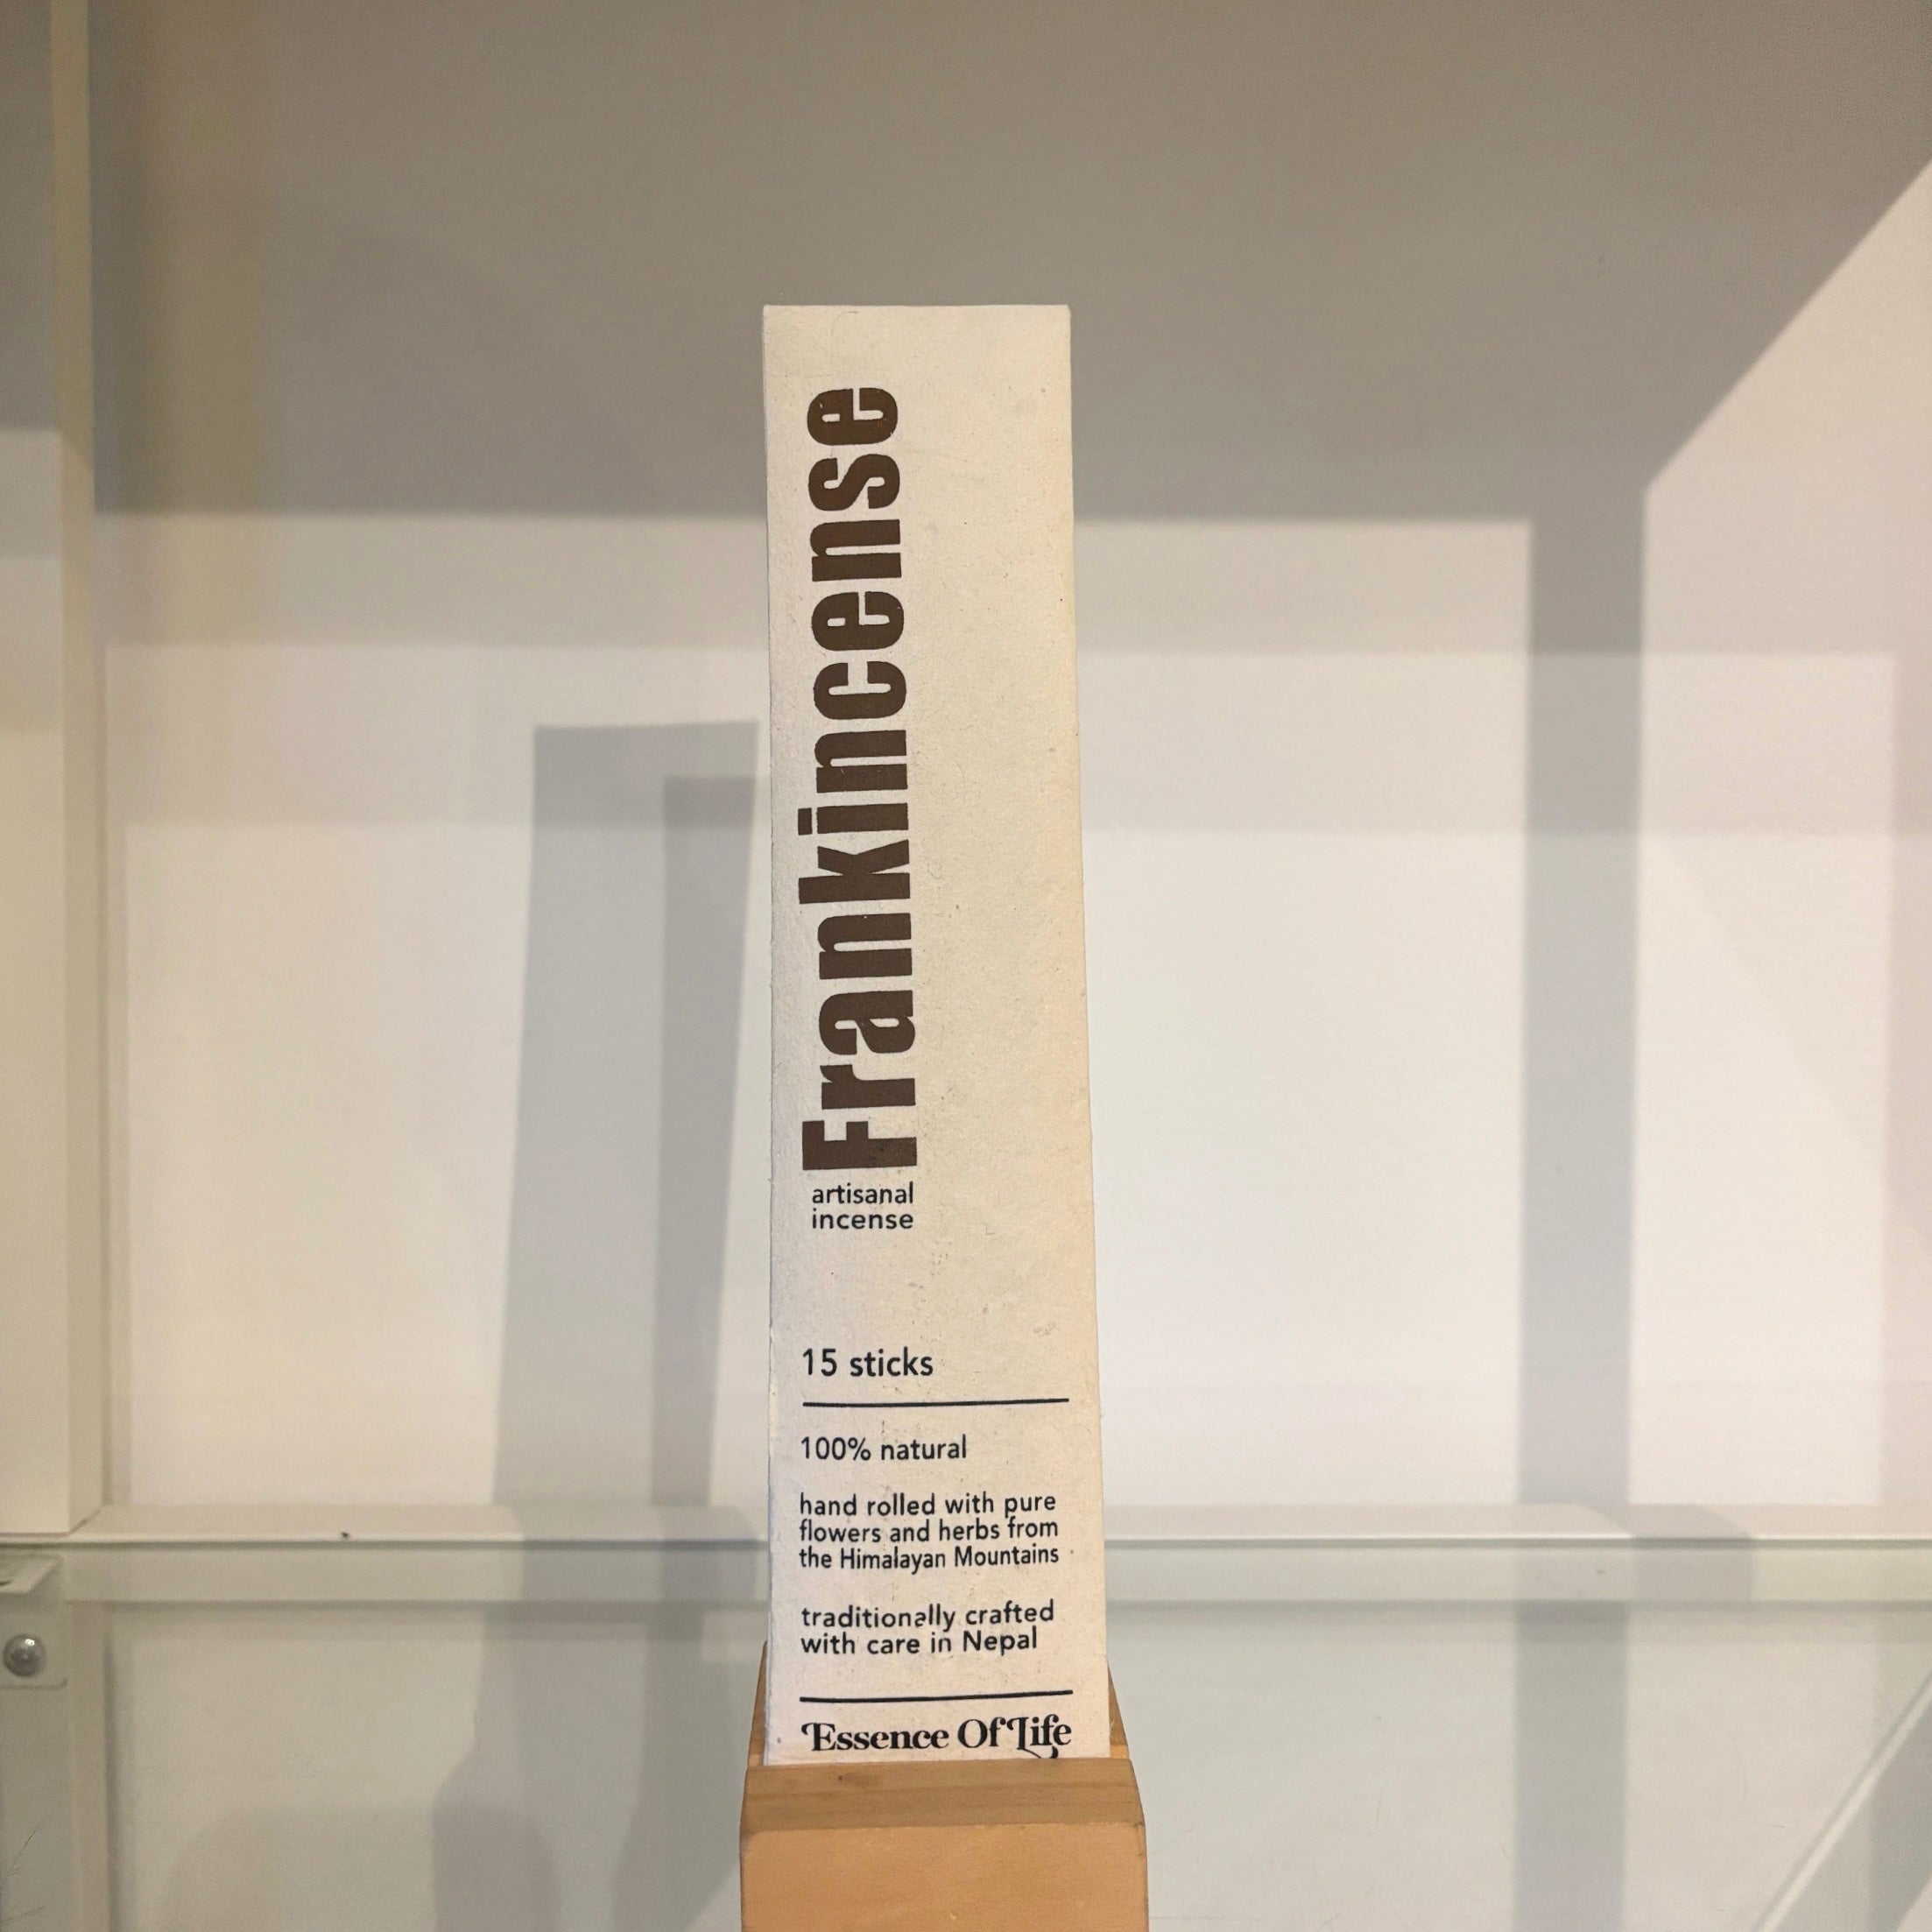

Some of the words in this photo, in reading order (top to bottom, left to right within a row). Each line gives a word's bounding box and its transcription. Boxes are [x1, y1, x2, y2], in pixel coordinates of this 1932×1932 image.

[798, 385, 919, 1172] Frankincense
[812, 1181, 913, 1205] artisanal
[812, 1209, 913, 1230] incense
[802, 1348, 837, 1377] 15
[850, 1346, 934, 1377] sticks
[801, 1437, 871, 1461] 100%
[880, 1434, 967, 1460] natural
[800, 1493, 857, 1516] hand
[868, 1492, 935, 1515] rolled
[945, 1491, 994, 1514] with
[1005, 1493, 1056, 1518] pure
[800, 1520, 880, 1543] flowers
[890, 1520, 929, 1542] and
[939, 1518, 1000, 1541] herbs
[1008, 1516, 1059, 1538] from
[800, 1548, 832, 1569] the
[841, 1547, 946, 1574] Himalayan
[955, 1543, 1059, 1567] Mountains
[801, 1604, 955, 1632] traditionally
[965, 1599, 1054, 1625] crafted
[801, 1633, 855, 1654] with
[867, 1635, 920, 1654] care
[931, 1632, 951, 1653] in
[962, 1626, 1037, 1656] Nepal
[801, 1722, 948, 1752] Essence
[957, 1717, 1006, 1748] Of
[1007, 1714, 1071, 1759] Life
